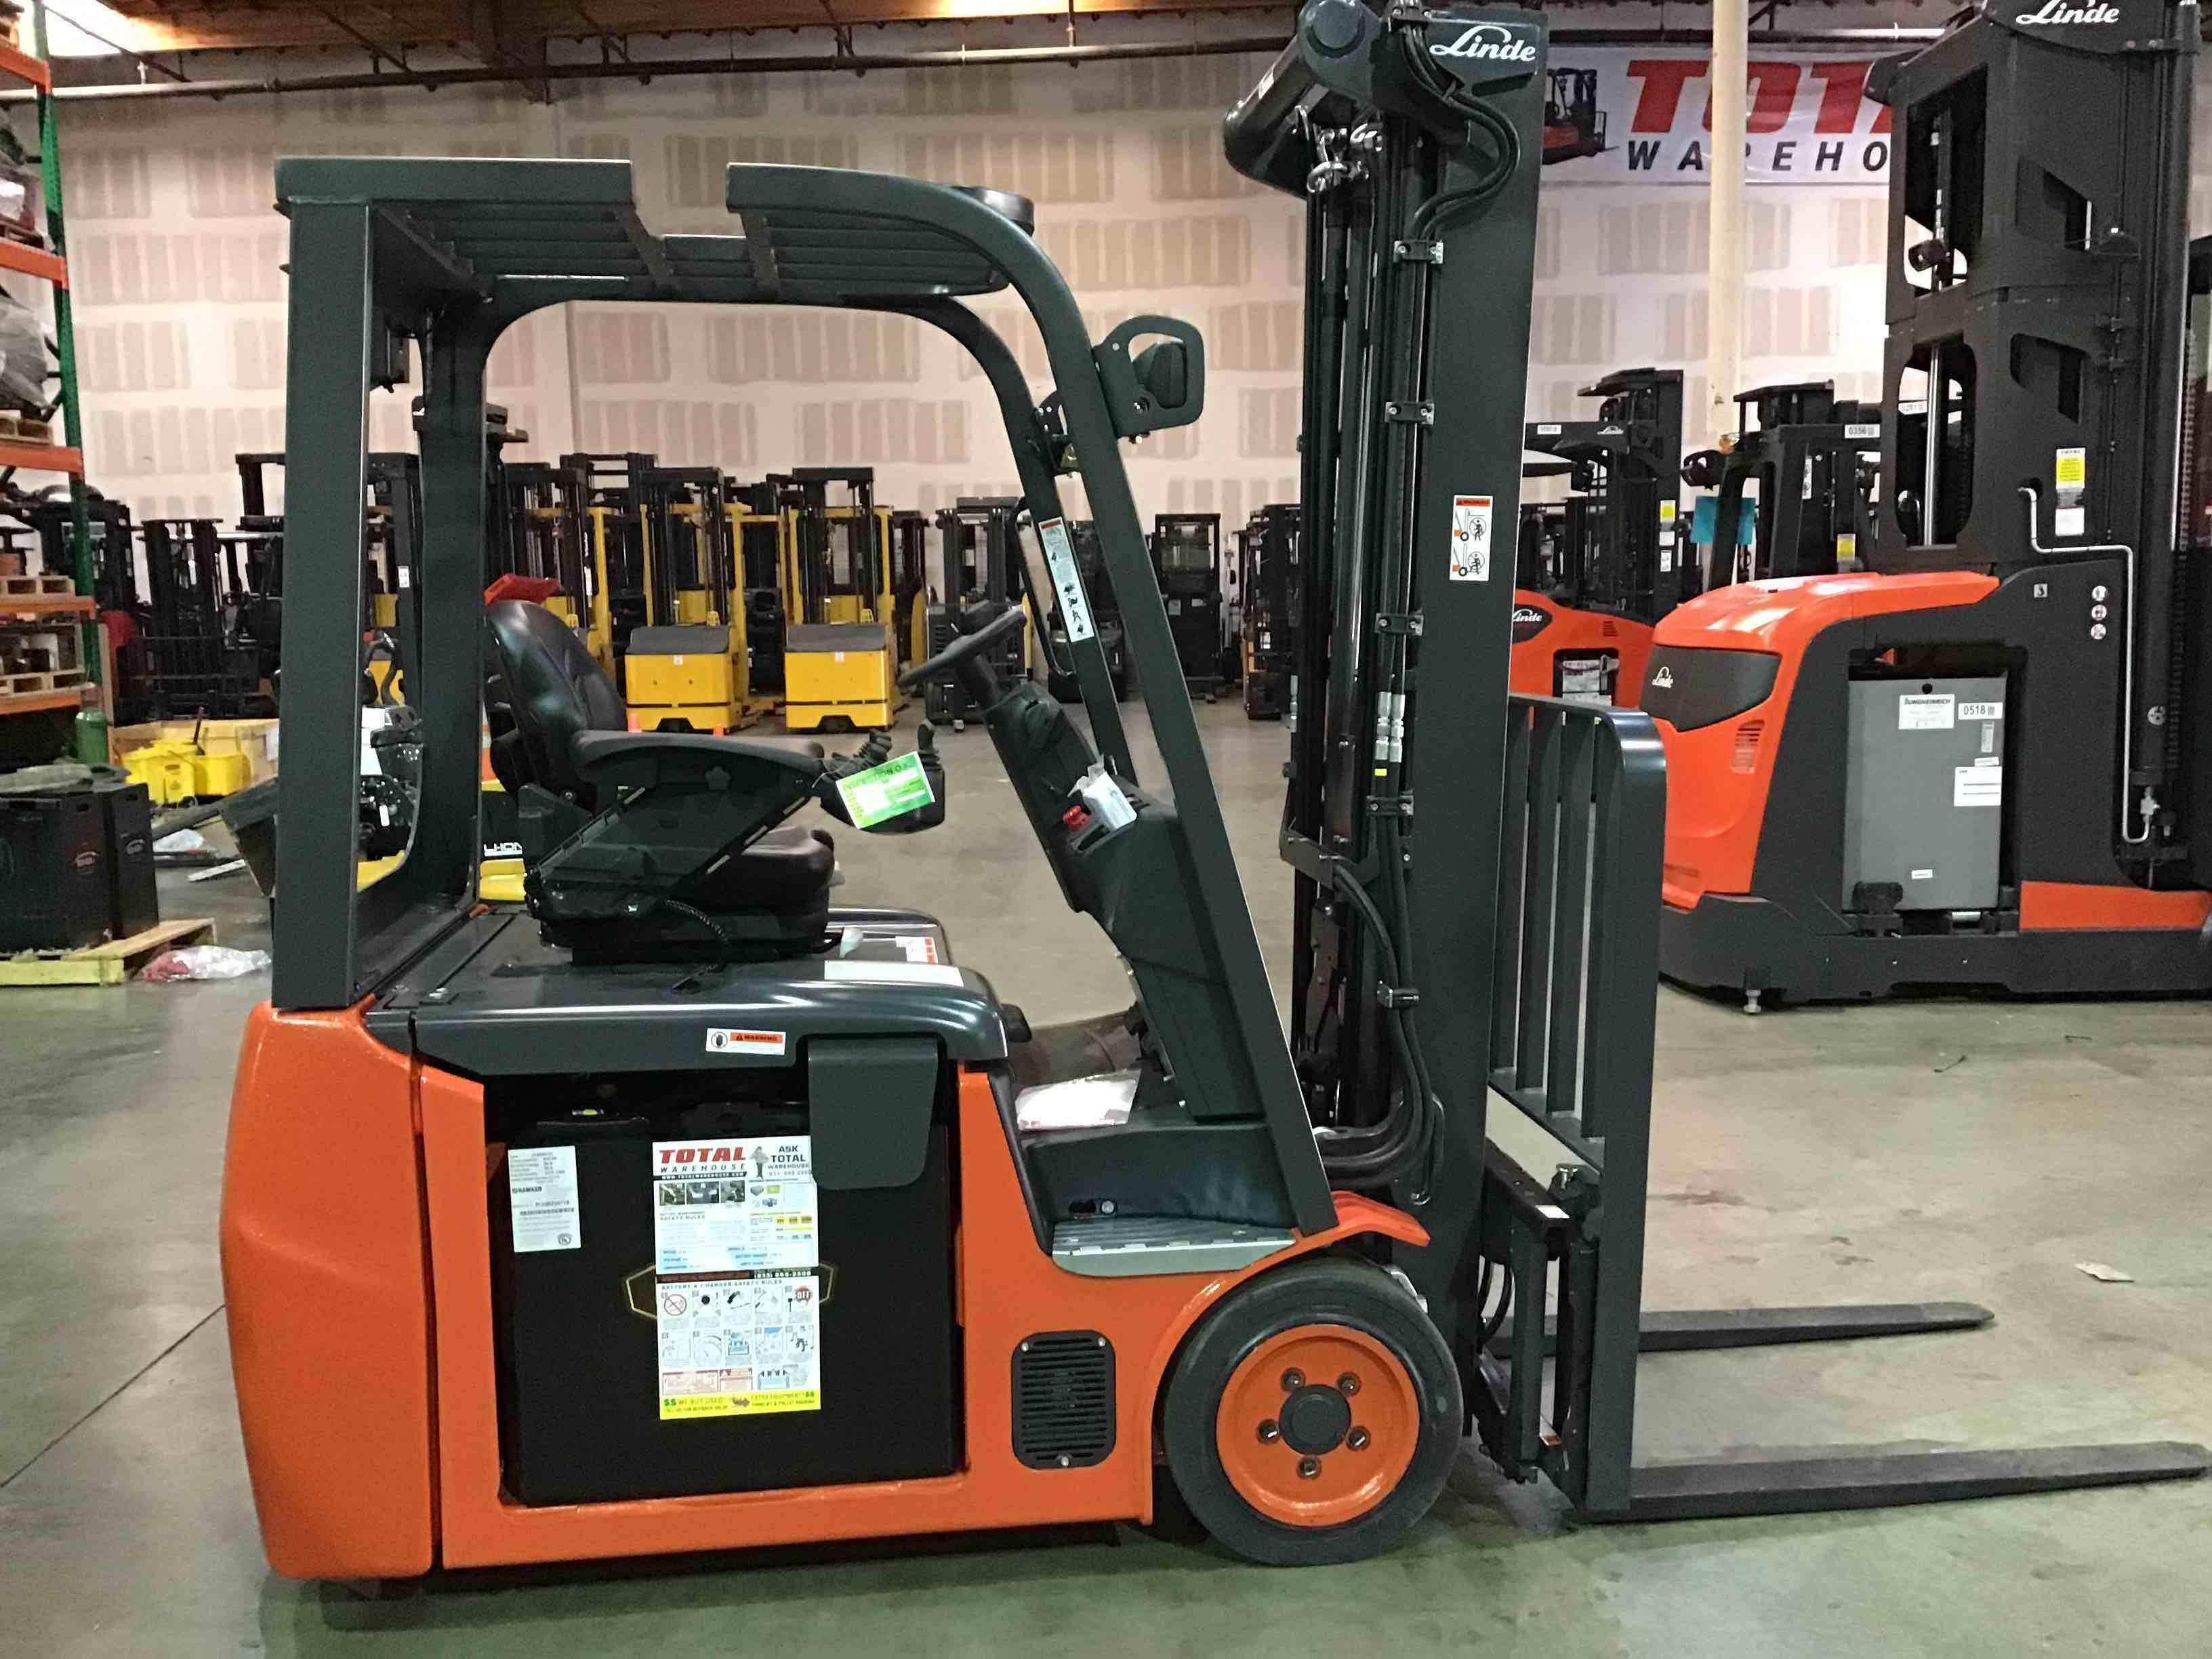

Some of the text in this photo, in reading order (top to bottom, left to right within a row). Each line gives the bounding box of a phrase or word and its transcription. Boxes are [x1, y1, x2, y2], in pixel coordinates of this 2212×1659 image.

[2015, 0, 2119, 24] Linde
[1429, 25, 1536, 62] Linde
[1627, 60, 1891, 134] TOT
[1629, 140, 1889, 171] WAEHO
[1963, 705, 1986, 715] 0518
[659, 1147, 746, 1164] TOTAL
[771, 1154, 806, 1163] TOTAL
[660, 1163, 745, 1173] WAREHOUSE
